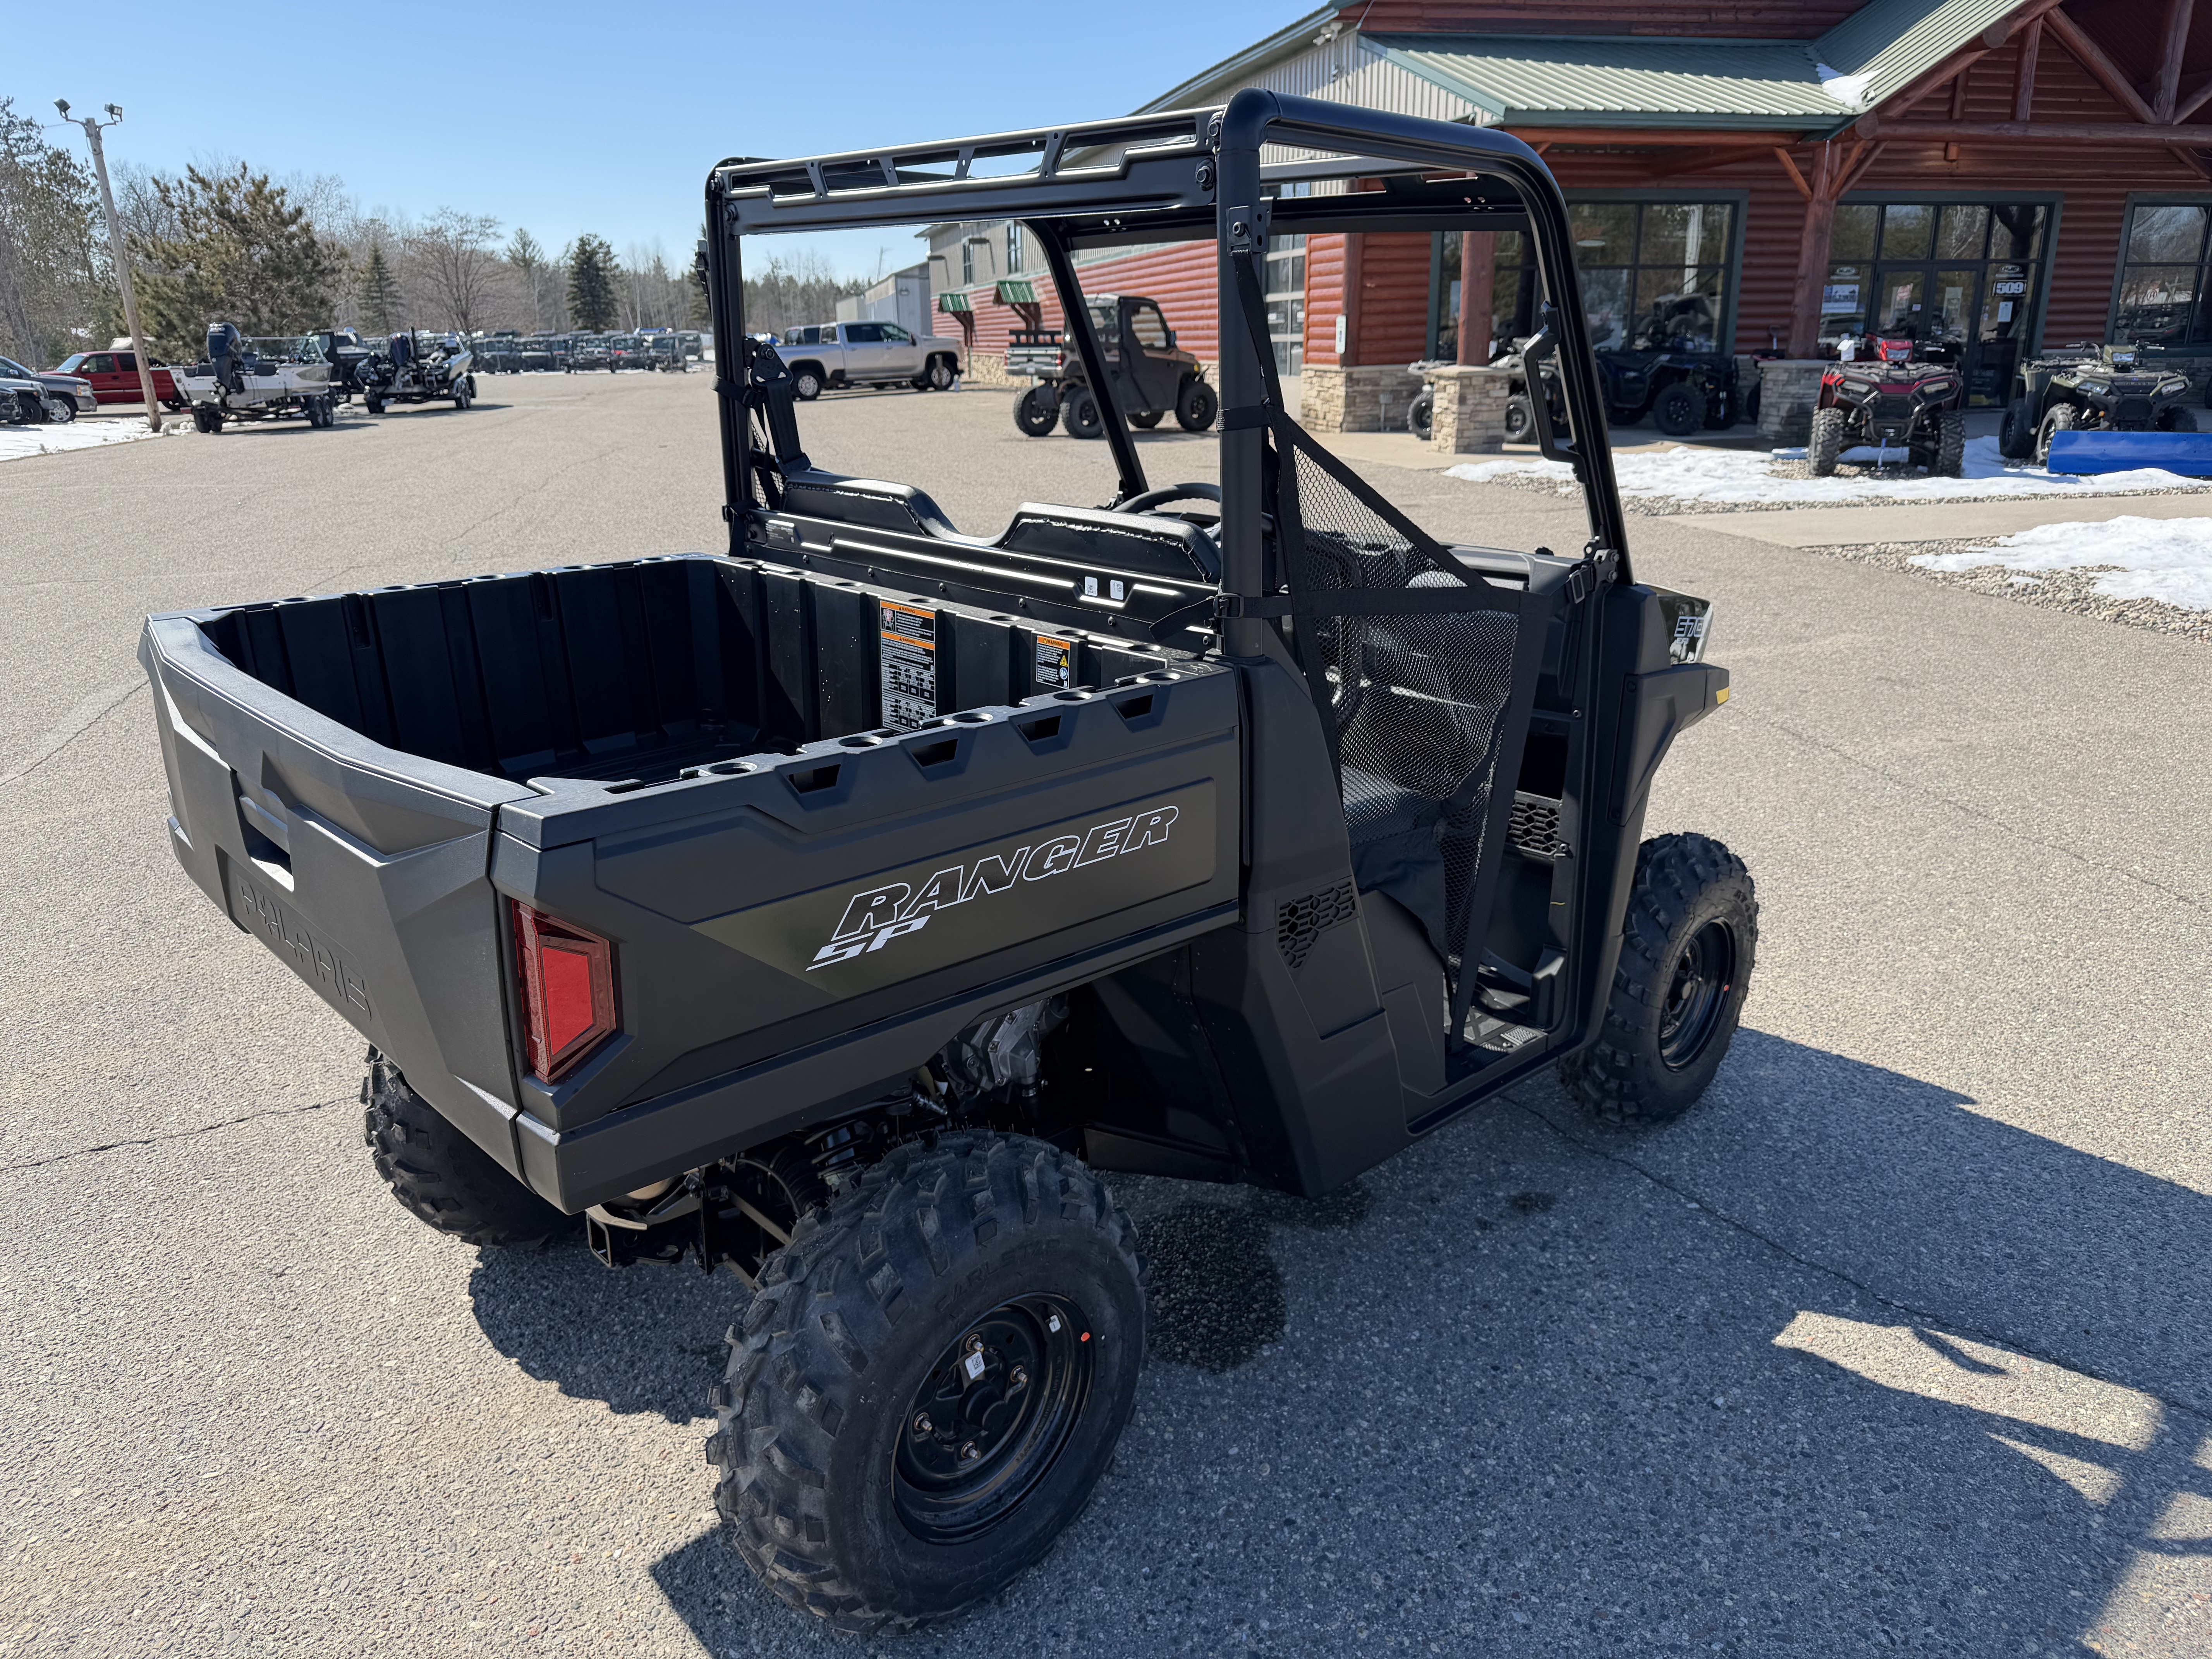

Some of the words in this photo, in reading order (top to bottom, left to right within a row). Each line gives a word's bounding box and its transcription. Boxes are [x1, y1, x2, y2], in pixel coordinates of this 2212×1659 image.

[1996, 282, 2024, 294] 509
[1674, 616, 1704, 637] 570
[831, 805, 1179, 941] RANGER
[237, 874, 372, 1022] POLARIS
[805, 914, 931, 972] SP
